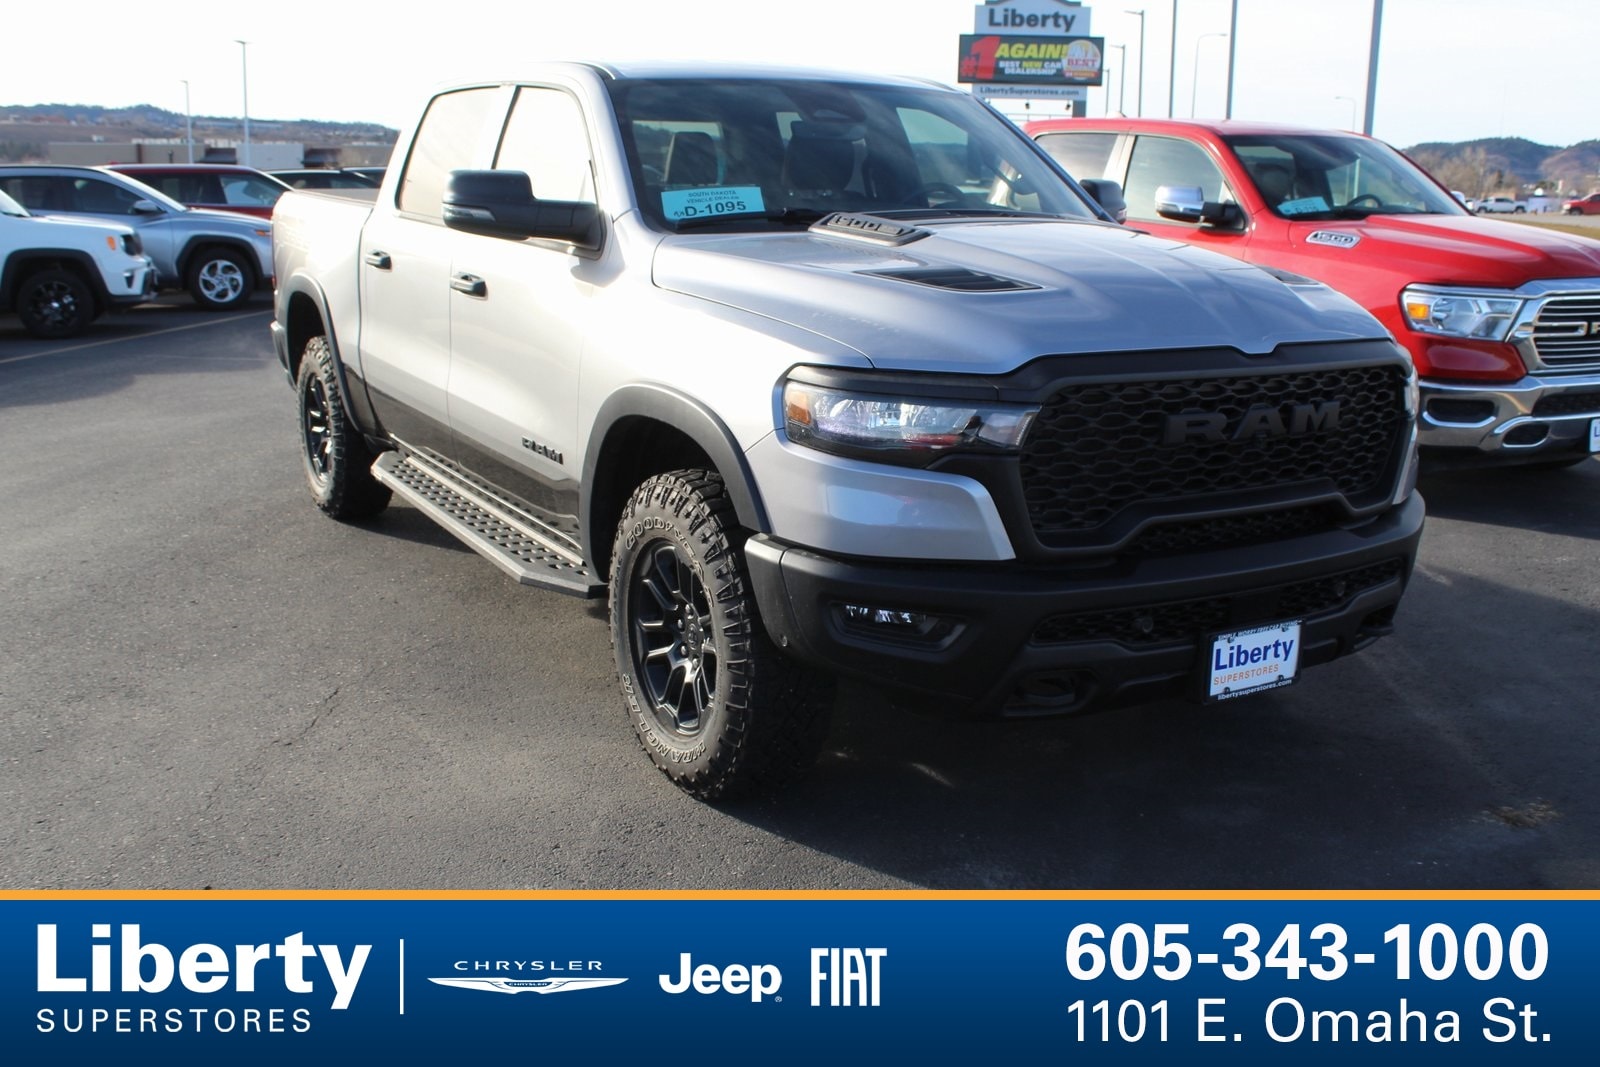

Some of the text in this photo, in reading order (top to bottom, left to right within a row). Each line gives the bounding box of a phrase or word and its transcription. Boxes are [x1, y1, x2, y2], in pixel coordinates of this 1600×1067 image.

[988, 8, 1076, 32] Liberty
[1004, 67, 1057, 76] DEALERSHIP
[980, 86, 1079, 96] LibertySuperstores.com
[684, 201, 747, 217] D-1095
[686, 196, 713, 204] VEHICLE
[1164, 400, 1341, 445] RAM
[1214, 639, 1294, 671] Liberty
[1213, 664, 1279, 686] SUPERSTORES
[1217, 679, 1292, 700] libertysuperstores.com
